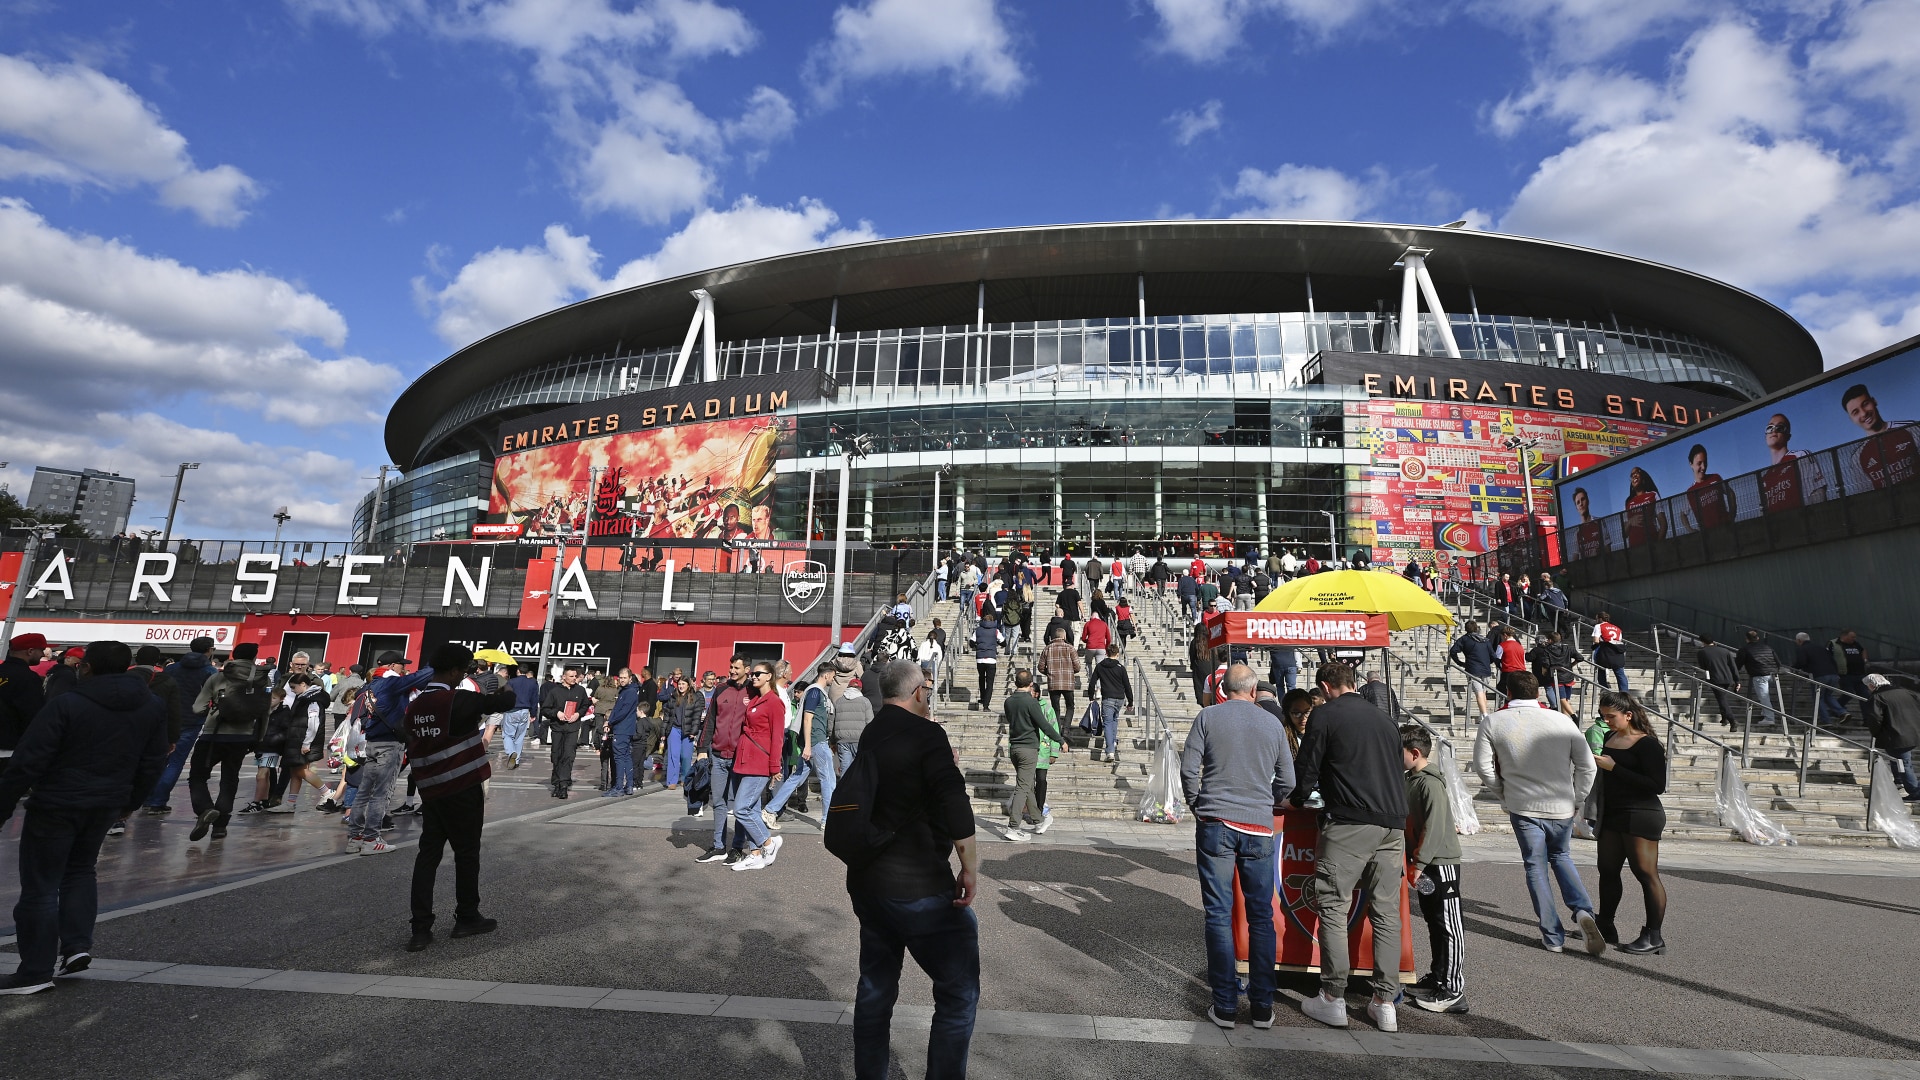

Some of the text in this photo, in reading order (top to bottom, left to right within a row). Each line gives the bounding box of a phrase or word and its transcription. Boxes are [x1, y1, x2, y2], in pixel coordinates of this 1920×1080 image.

[1364, 373, 1719, 425] EMIRATES STADI
[503, 390, 789, 452] EMIRATES STADIUM
[1391, 418, 1415, 429] ARSENAL
[1433, 420, 1455, 431] ISLANDS
[1517, 427, 1563, 442] Arsenal
[1566, 430, 1627, 445] ARSENAL MALDIVES
[573, 515, 642, 537] Emirates
[26, 548, 695, 611] ARSENAL
[788, 570, 821, 579] Arsenal
[145, 628, 171, 640] BOX
[1246, 618, 1367, 641] PROGRAMMES
[414, 714, 435, 725] Here
